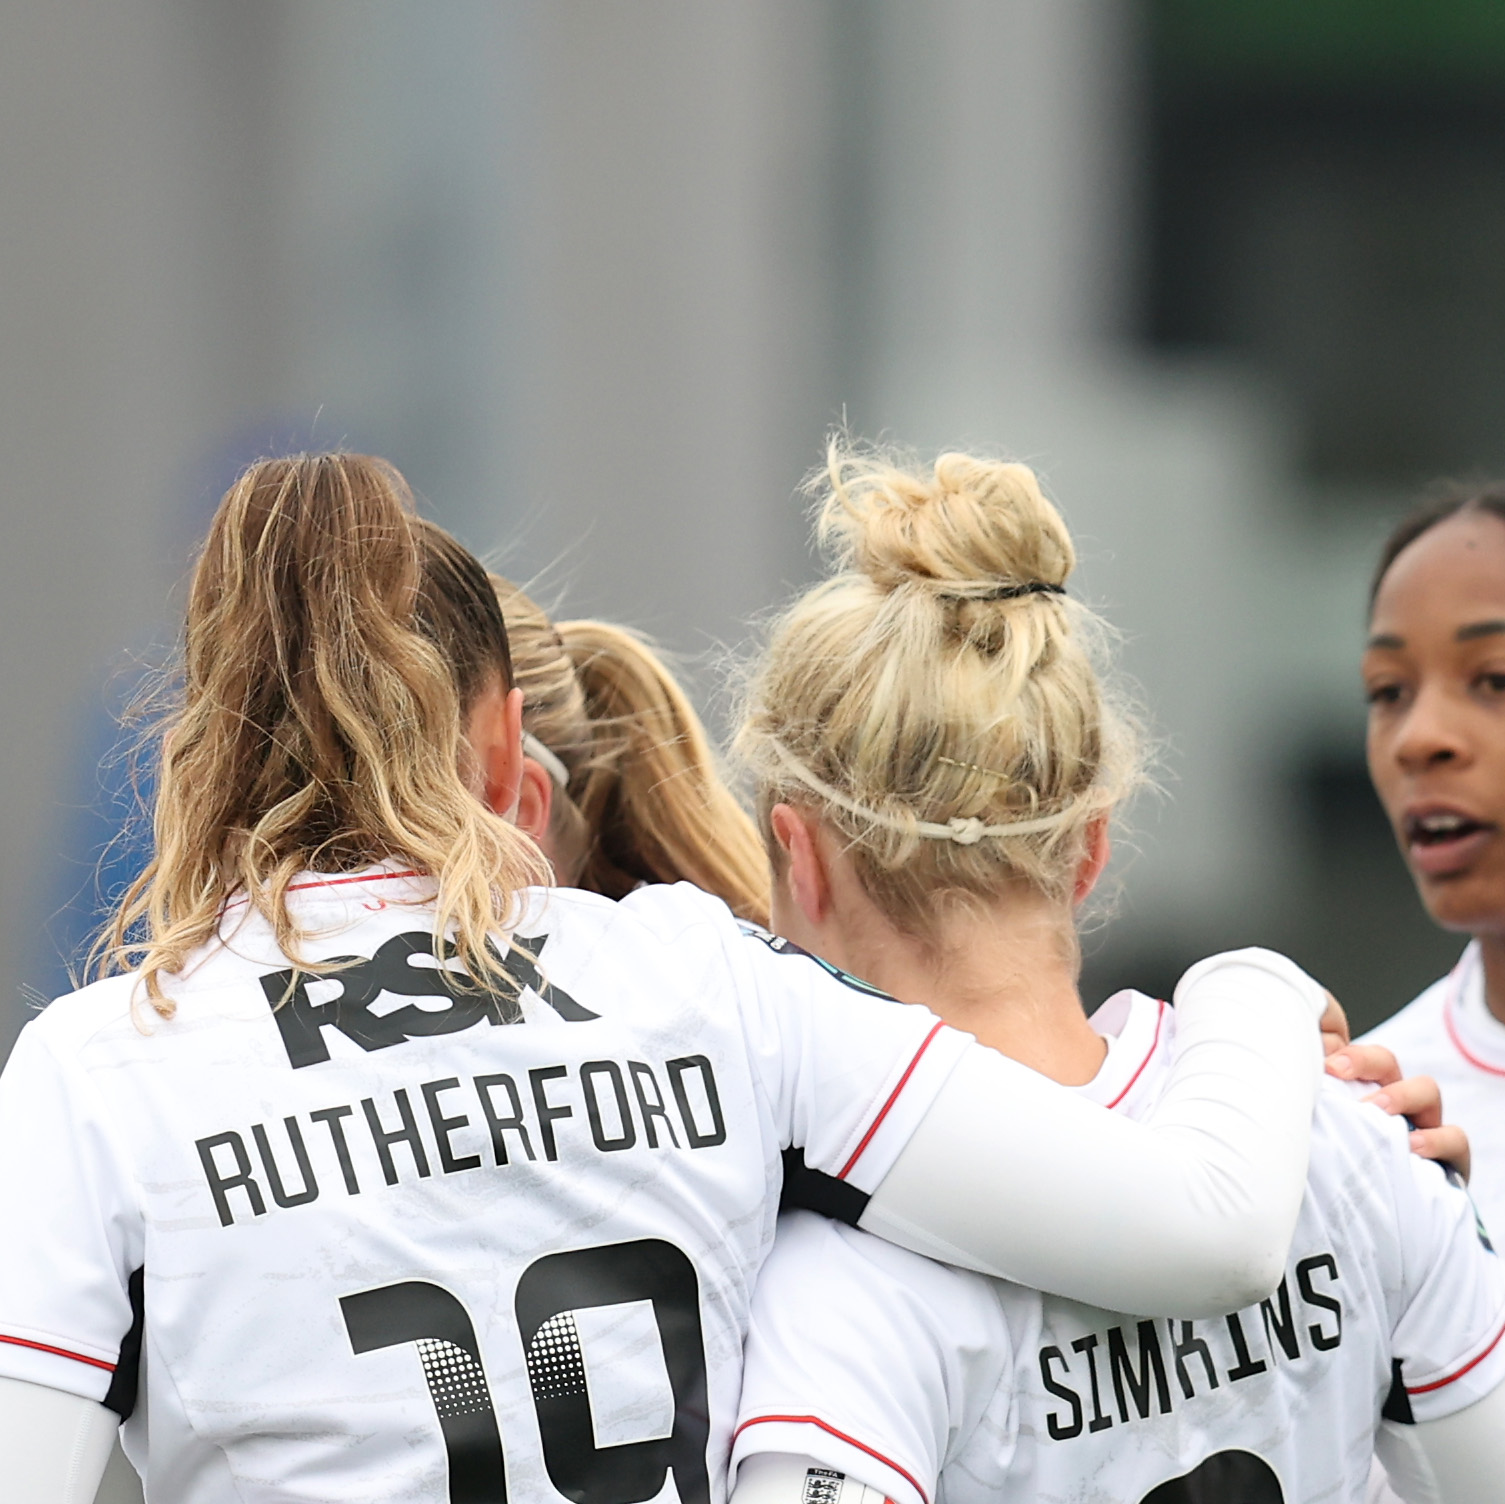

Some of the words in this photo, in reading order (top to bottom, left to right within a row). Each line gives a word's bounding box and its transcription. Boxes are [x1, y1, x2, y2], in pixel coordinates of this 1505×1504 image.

[259, 931, 603, 1069] RSK
[195, 1054, 727, 1228] RUTHERFORD
[1038, 1253, 1340, 1441] SIMKINS
